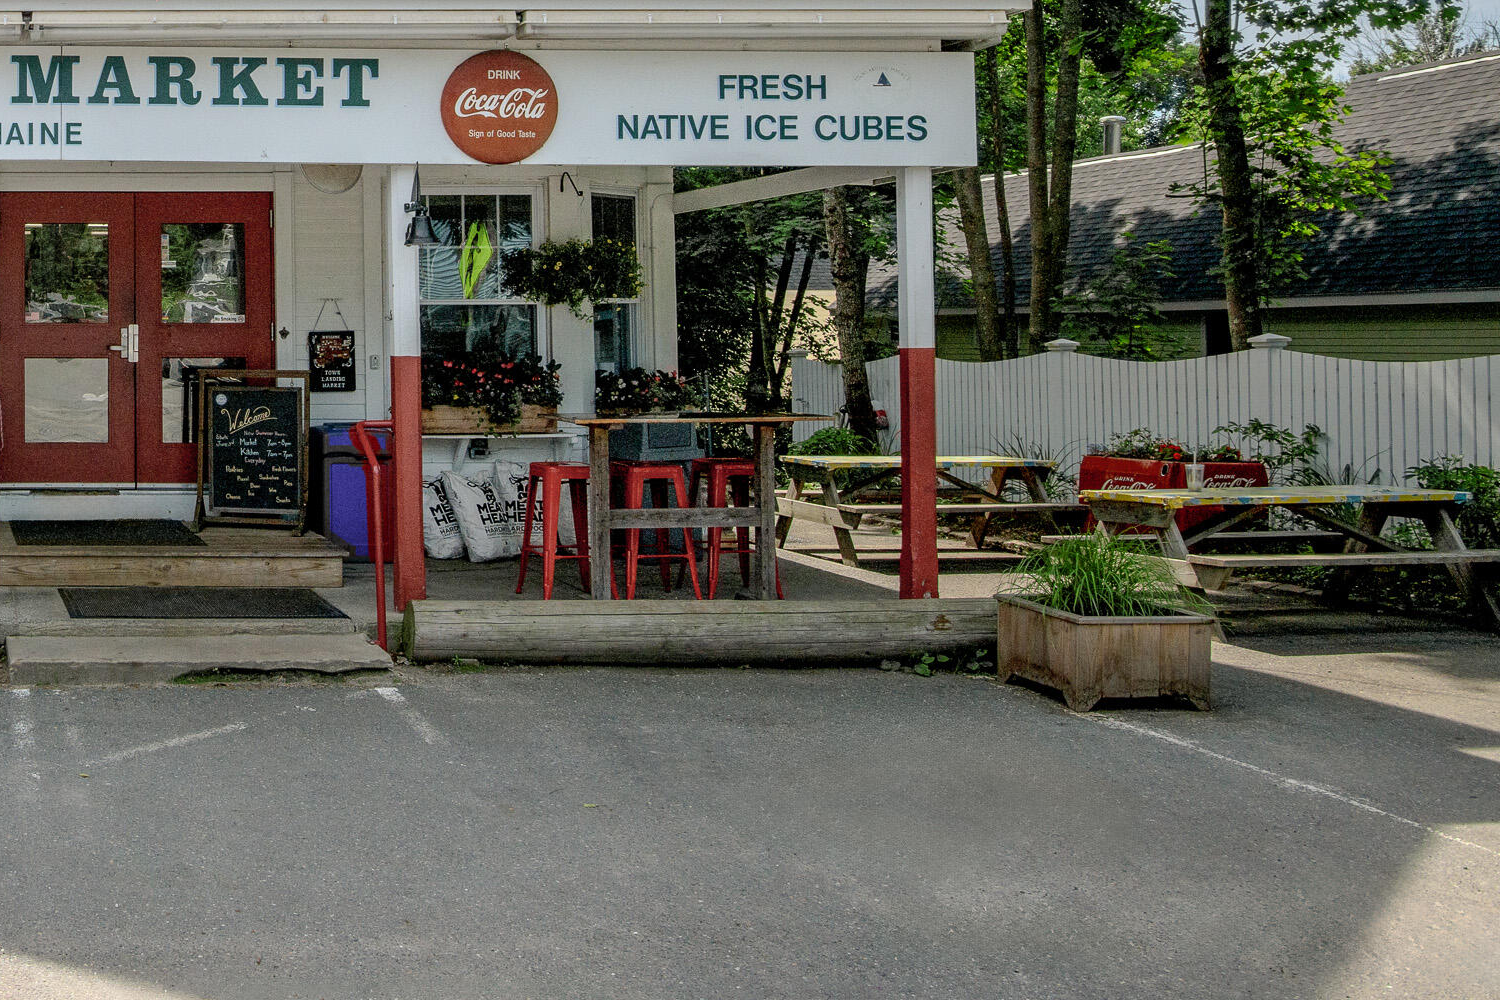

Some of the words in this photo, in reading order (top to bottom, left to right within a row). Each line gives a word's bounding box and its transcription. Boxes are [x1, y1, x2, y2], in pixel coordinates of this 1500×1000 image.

[11, 54, 380, 107] MARKET
[487, 69, 521, 80] DRINK
[718, 73, 827, 100] FRESH
[454, 87, 549, 119] Coca-Cola
[468, 129, 485, 139] Sign
[486, 130, 495, 138] of
[496, 130, 516, 138] Good
[518, 129, 537, 138] Taste
[617, 114, 730, 140] NATIVE
[745, 114, 799, 140] ICE
[814, 114, 928, 141] CUBES
[220, 405, 278, 434] Welcome
